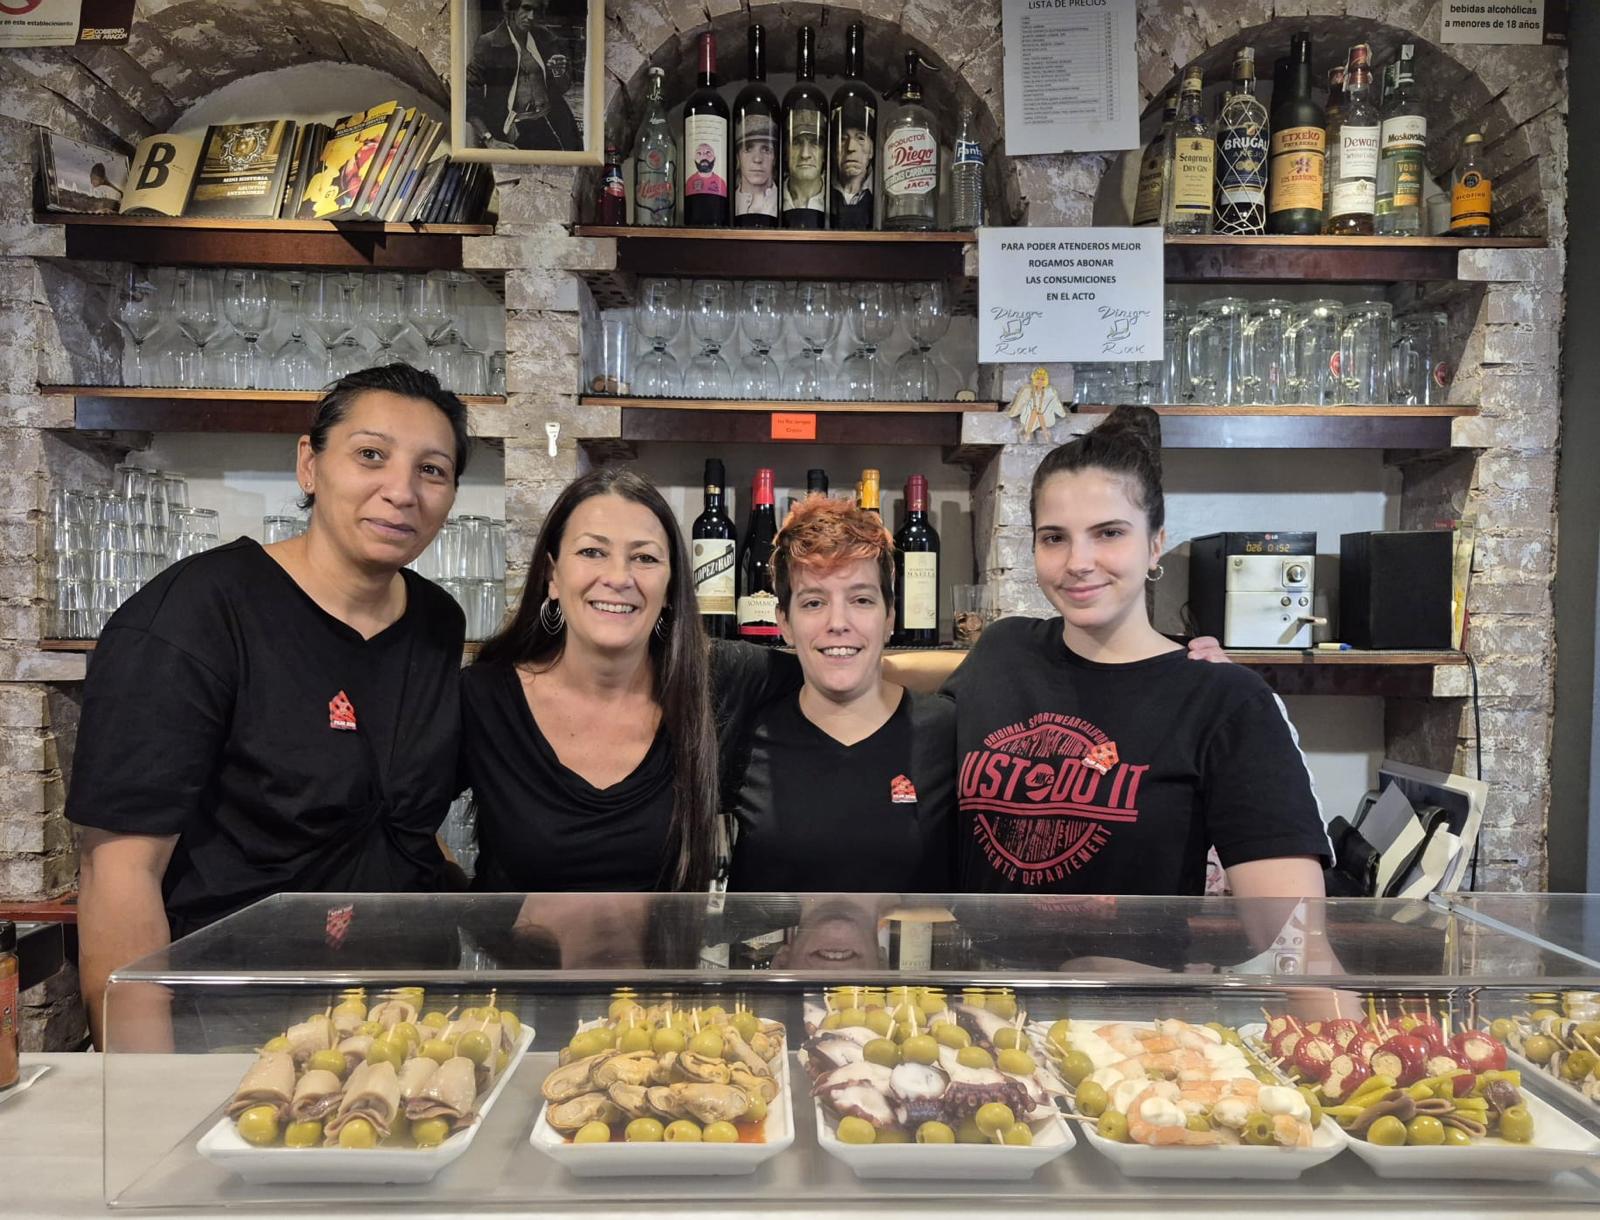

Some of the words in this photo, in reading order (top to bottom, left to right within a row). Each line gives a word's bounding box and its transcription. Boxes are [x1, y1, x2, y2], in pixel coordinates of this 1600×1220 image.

[1028, 0, 1053, 9] LISTA
[1055, 0, 1067, 8] DE
[1450, 4, 1486, 14] bebidas
[1487, 4, 1538, 15] alcohólicas
[1444, 20, 1450, 28] a
[1452, 20, 1491, 28] menores
[1492, 19, 1504, 28] de
[1506, 20, 1517, 29] 18
[1518, 20, 1540, 29] años
[894, 146, 934, 168] Diego
[135, 142, 177, 190] B
[904, 181, 930, 189] JACA
[1001, 243, 1025, 251] PARA
[1027, 243, 1057, 251] PODER
[1058, 242, 1110, 251] ATENDEROS
[1112, 242, 1141, 251] MEJOR
[1028, 259, 1075, 268] ROGAMOS
[1076, 259, 1114, 268] ABONAR
[1025, 276, 1041, 284] LAS
[1043, 275, 1117, 284] CONSUMICIONES
[1046, 292, 1059, 301] EN
[1060, 292, 1071, 301] EL
[1072, 292, 1096, 301] ACTO
[983, 722, 1027, 747] ORIGINAL
[1050, 758, 1102, 804] DO
[1107, 763, 1150, 809] IT
[971, 816, 1018, 882] UTHENTIC
